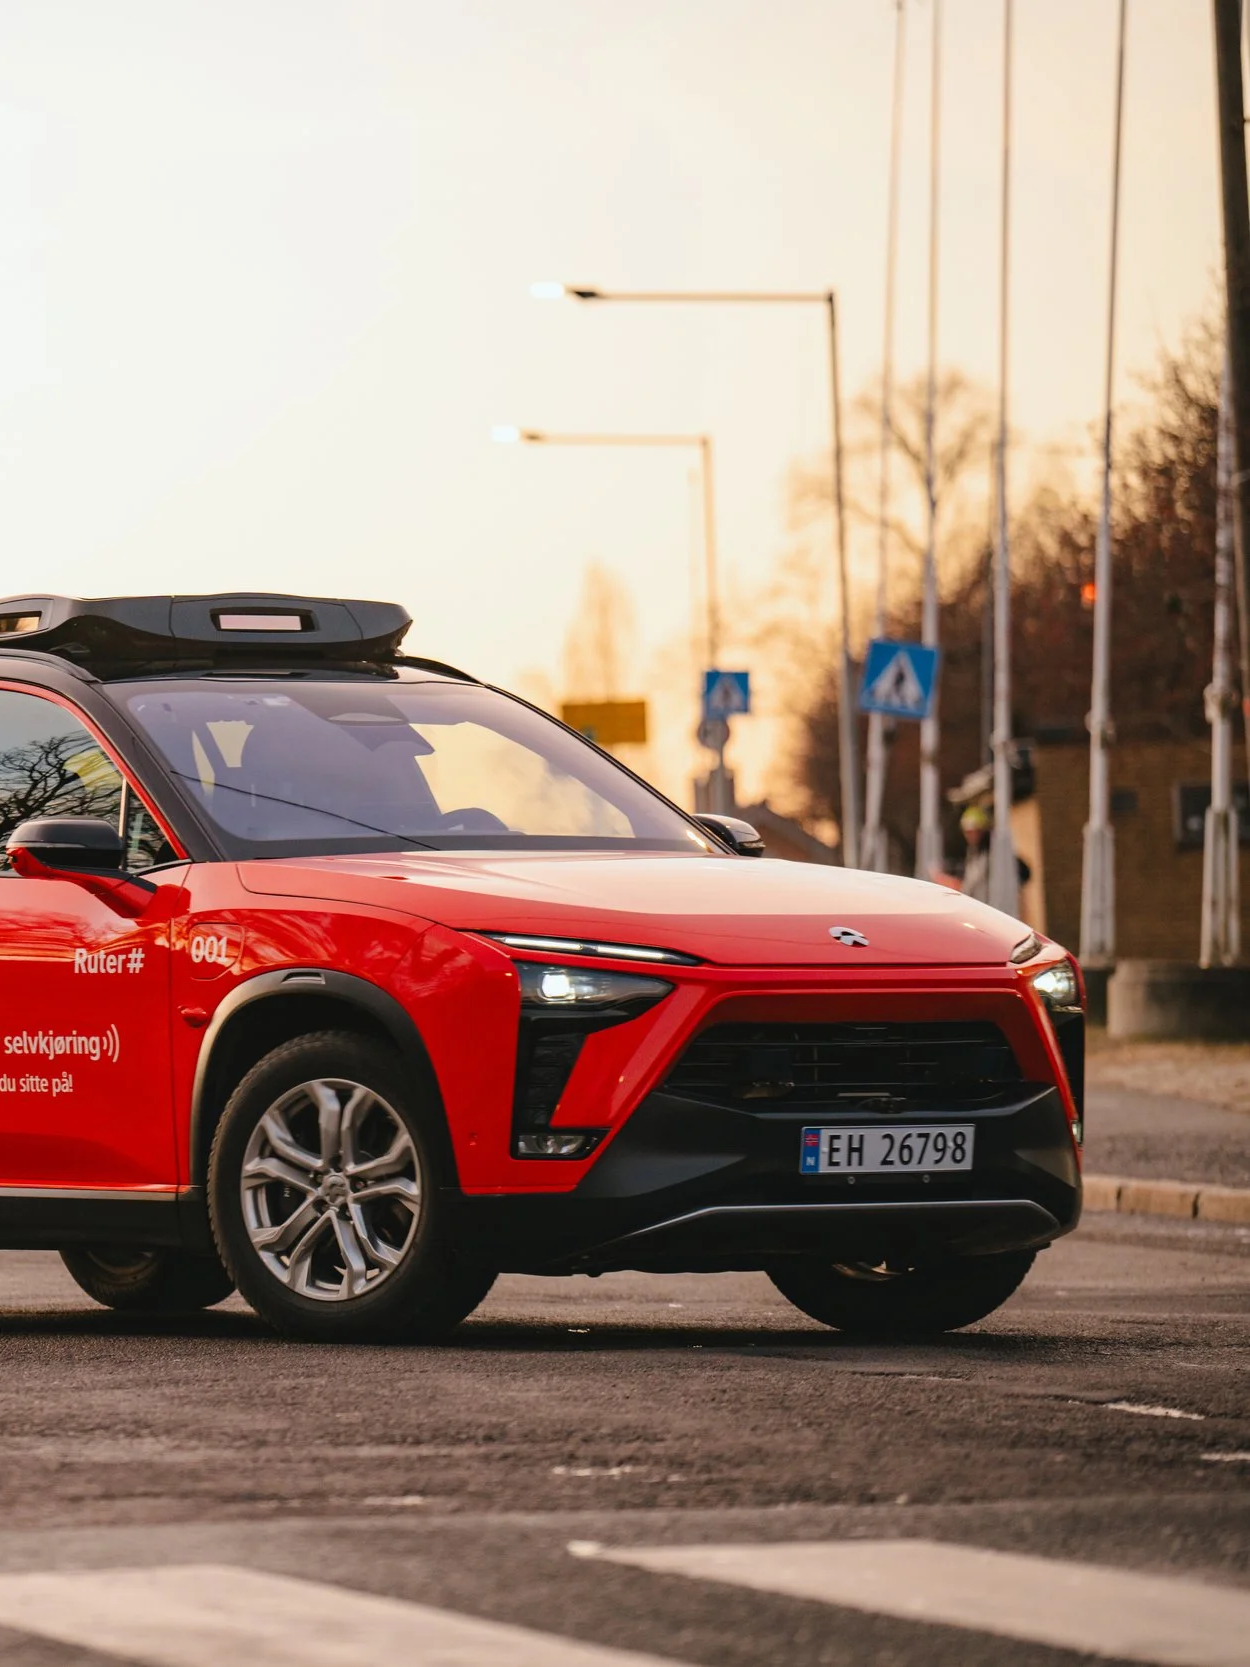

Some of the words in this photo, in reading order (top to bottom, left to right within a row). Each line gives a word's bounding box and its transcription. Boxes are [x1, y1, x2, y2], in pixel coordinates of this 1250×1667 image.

[74, 948, 145, 974] Ruter#
[191, 936, 228, 963] 001
[4, 1030, 101, 1061] selvkjøring
[19, 1074, 49, 1093] sitte
[52, 1071, 73, 1097] på!
[806, 1156, 815, 1166] N
[827, 1134, 864, 1167] EH
[880, 1131, 966, 1166] 26798
